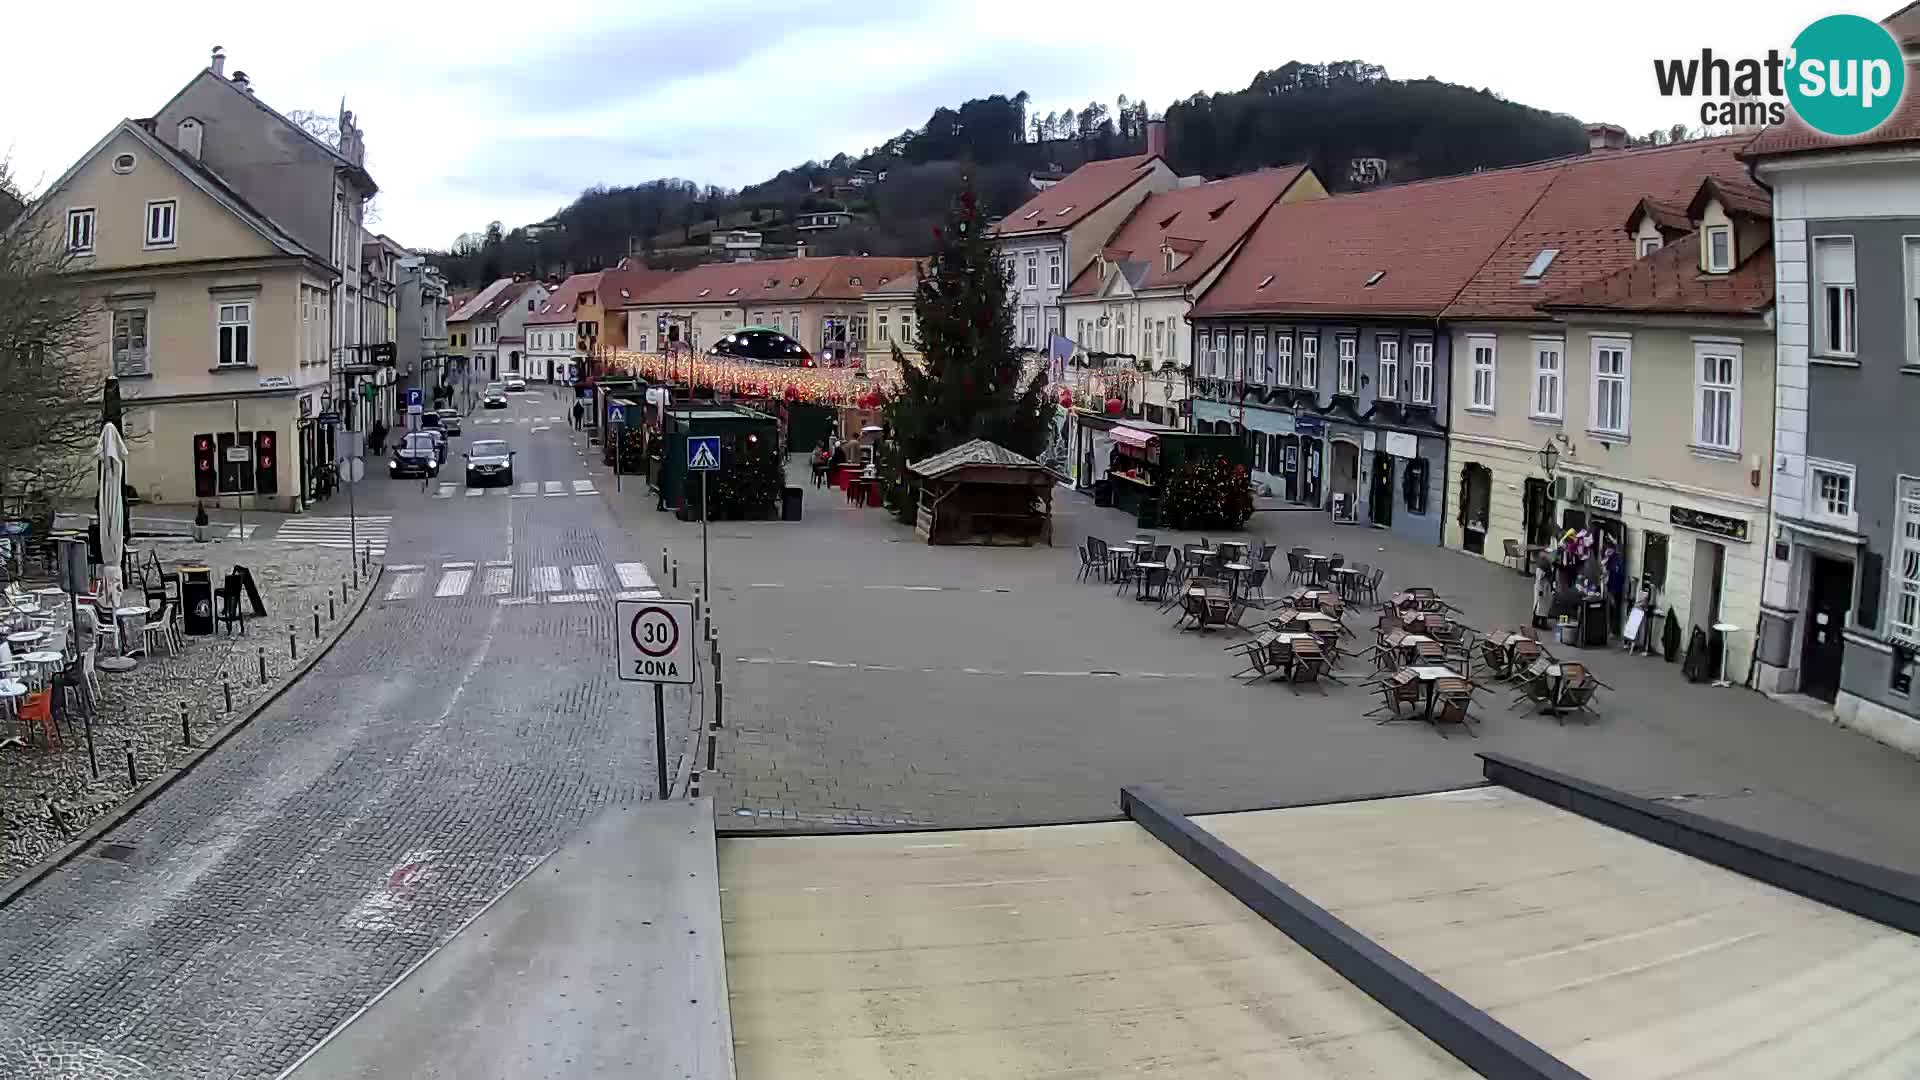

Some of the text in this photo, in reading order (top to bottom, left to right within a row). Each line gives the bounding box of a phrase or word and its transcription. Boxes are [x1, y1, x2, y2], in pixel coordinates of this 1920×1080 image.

[411, 391, 419, 403] P
[643, 622, 668, 644] 30
[634, 660, 679, 676] ZONA
